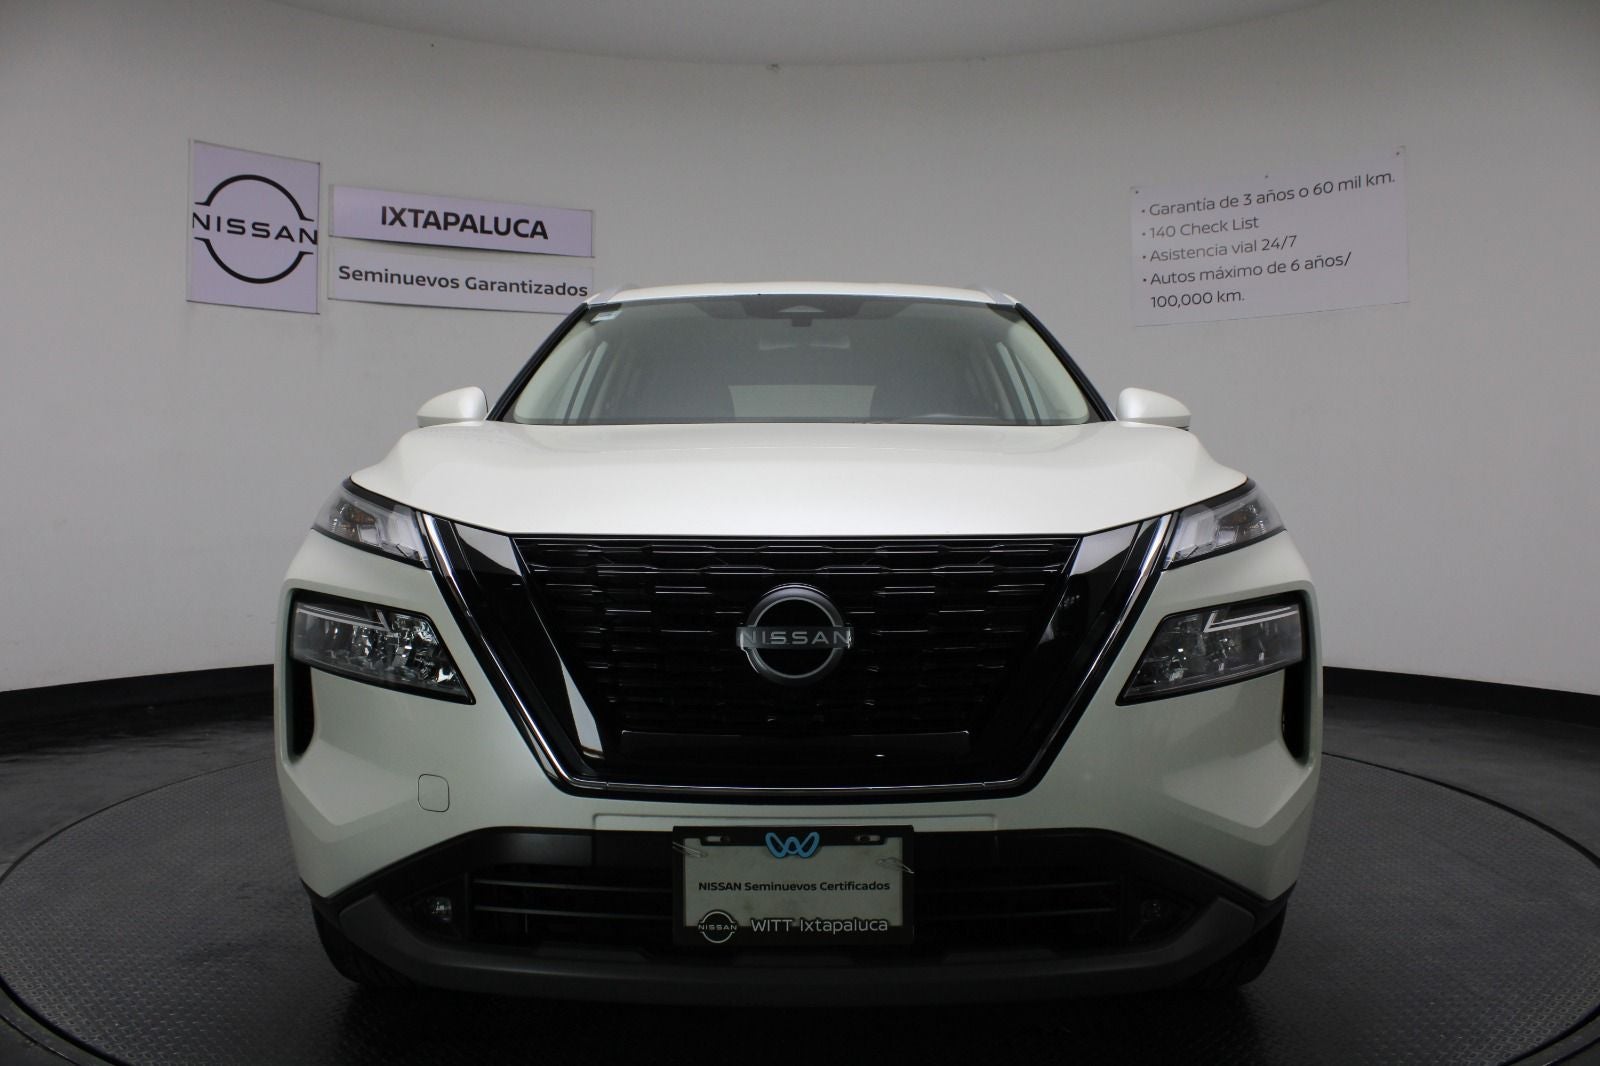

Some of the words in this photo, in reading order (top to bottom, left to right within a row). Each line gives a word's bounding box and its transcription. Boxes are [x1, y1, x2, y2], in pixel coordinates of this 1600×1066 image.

[1149, 194, 1215, 216] Garantía
[1219, 194, 1239, 208] de
[1243, 194, 1252, 206] 3
[1256, 188, 1295, 204] años
[1298, 188, 1309, 198] o
[1313, 181, 1334, 196] 60
[1338, 176, 1361, 192] mil
[1366, 171, 1396, 186] km.
[192, 212, 318, 245] NISSAN
[381, 206, 548, 240] IXTAPALUCA
[1150, 225, 1176, 239] 140
[1180, 220, 1228, 236] Check
[1232, 216, 1259, 231] List
[1150, 244, 1228, 262] Asistencia
[1231, 240, 1257, 254] vial
[1261, 235, 1297, 251] 24/7
[338, 265, 460, 289] Seminuevos
[465, 276, 588, 297] Garantizados
[1150, 270, 1196, 286] Autos
[1200, 263, 1263, 282] máximo
[1266, 261, 1287, 274] de
[1290, 259, 1300, 272] 6
[1304, 252, 1352, 270] años/
[1151, 292, 1213, 309] 100,000
[1217, 290, 1245, 304] km.
[739, 631, 851, 645] NISSAN
[698, 882, 741, 891] NISSAN
[745, 882, 817, 891] Seminuevos
[819, 881, 890, 891] Certificados
[751, 919, 792, 932] WITT
[800, 918, 888, 935] Ixtapaluca
